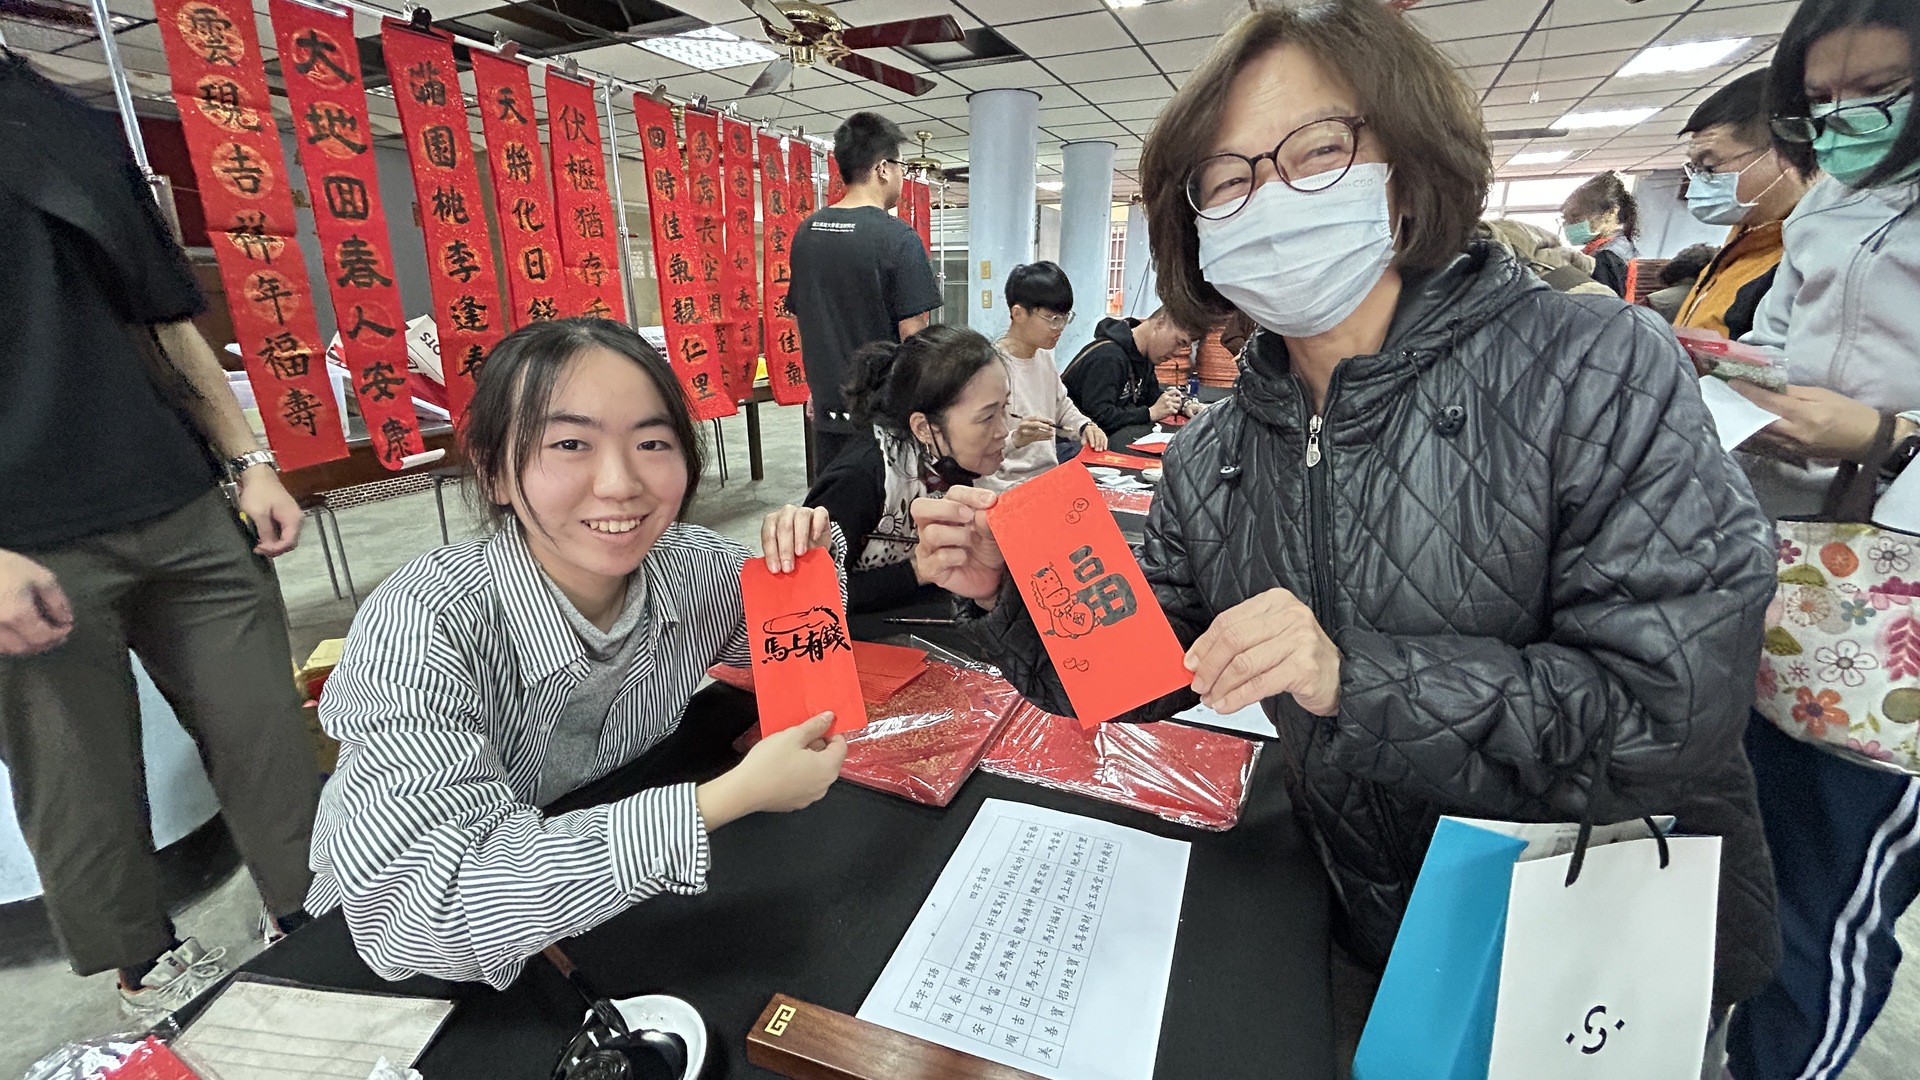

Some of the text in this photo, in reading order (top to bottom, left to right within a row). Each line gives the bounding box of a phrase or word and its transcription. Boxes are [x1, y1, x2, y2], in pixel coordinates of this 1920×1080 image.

[187, 5, 323, 438] 雲現吉祥年福壽
[761, 622, 851, 664] 馬上有錢
[1047, 831, 1064, 860] 一馬當先
[1056, 869, 1077, 904] 馬上加薪
[1084, 872, 1104, 911] 金玉滿堂
[1012, 897, 1037, 936] 龍馬精神
[1042, 905, 1065, 945] 馬到福到
[1071, 910, 1094, 953] 恭喜發財
[909, 867, 991, 1013] 單字吉語 四字吉語
[939, 1012, 954, 1025] 福
[957, 976, 971, 989] 樂
[1003, 856, 1025, 888] 馬到成功
[994, 939, 1021, 982] 金馬騰飛
[1025, 948, 1049, 992] 馬年大吉
[1055, 956, 1081, 1001] 招財進寶
[987, 985, 1002, 997] 富
[1019, 995, 1032, 1009] 旺
[979, 1004, 994, 1016] 喜
[1011, 1014, 1025, 1026] 吉
[1050, 1005, 1066, 1018] 寶
[971, 1023, 986, 1036] 安
[1004, 1033, 1020, 1048] 順
[1044, 1025, 1059, 1038] 善
[1037, 1046, 1054, 1060] 美
